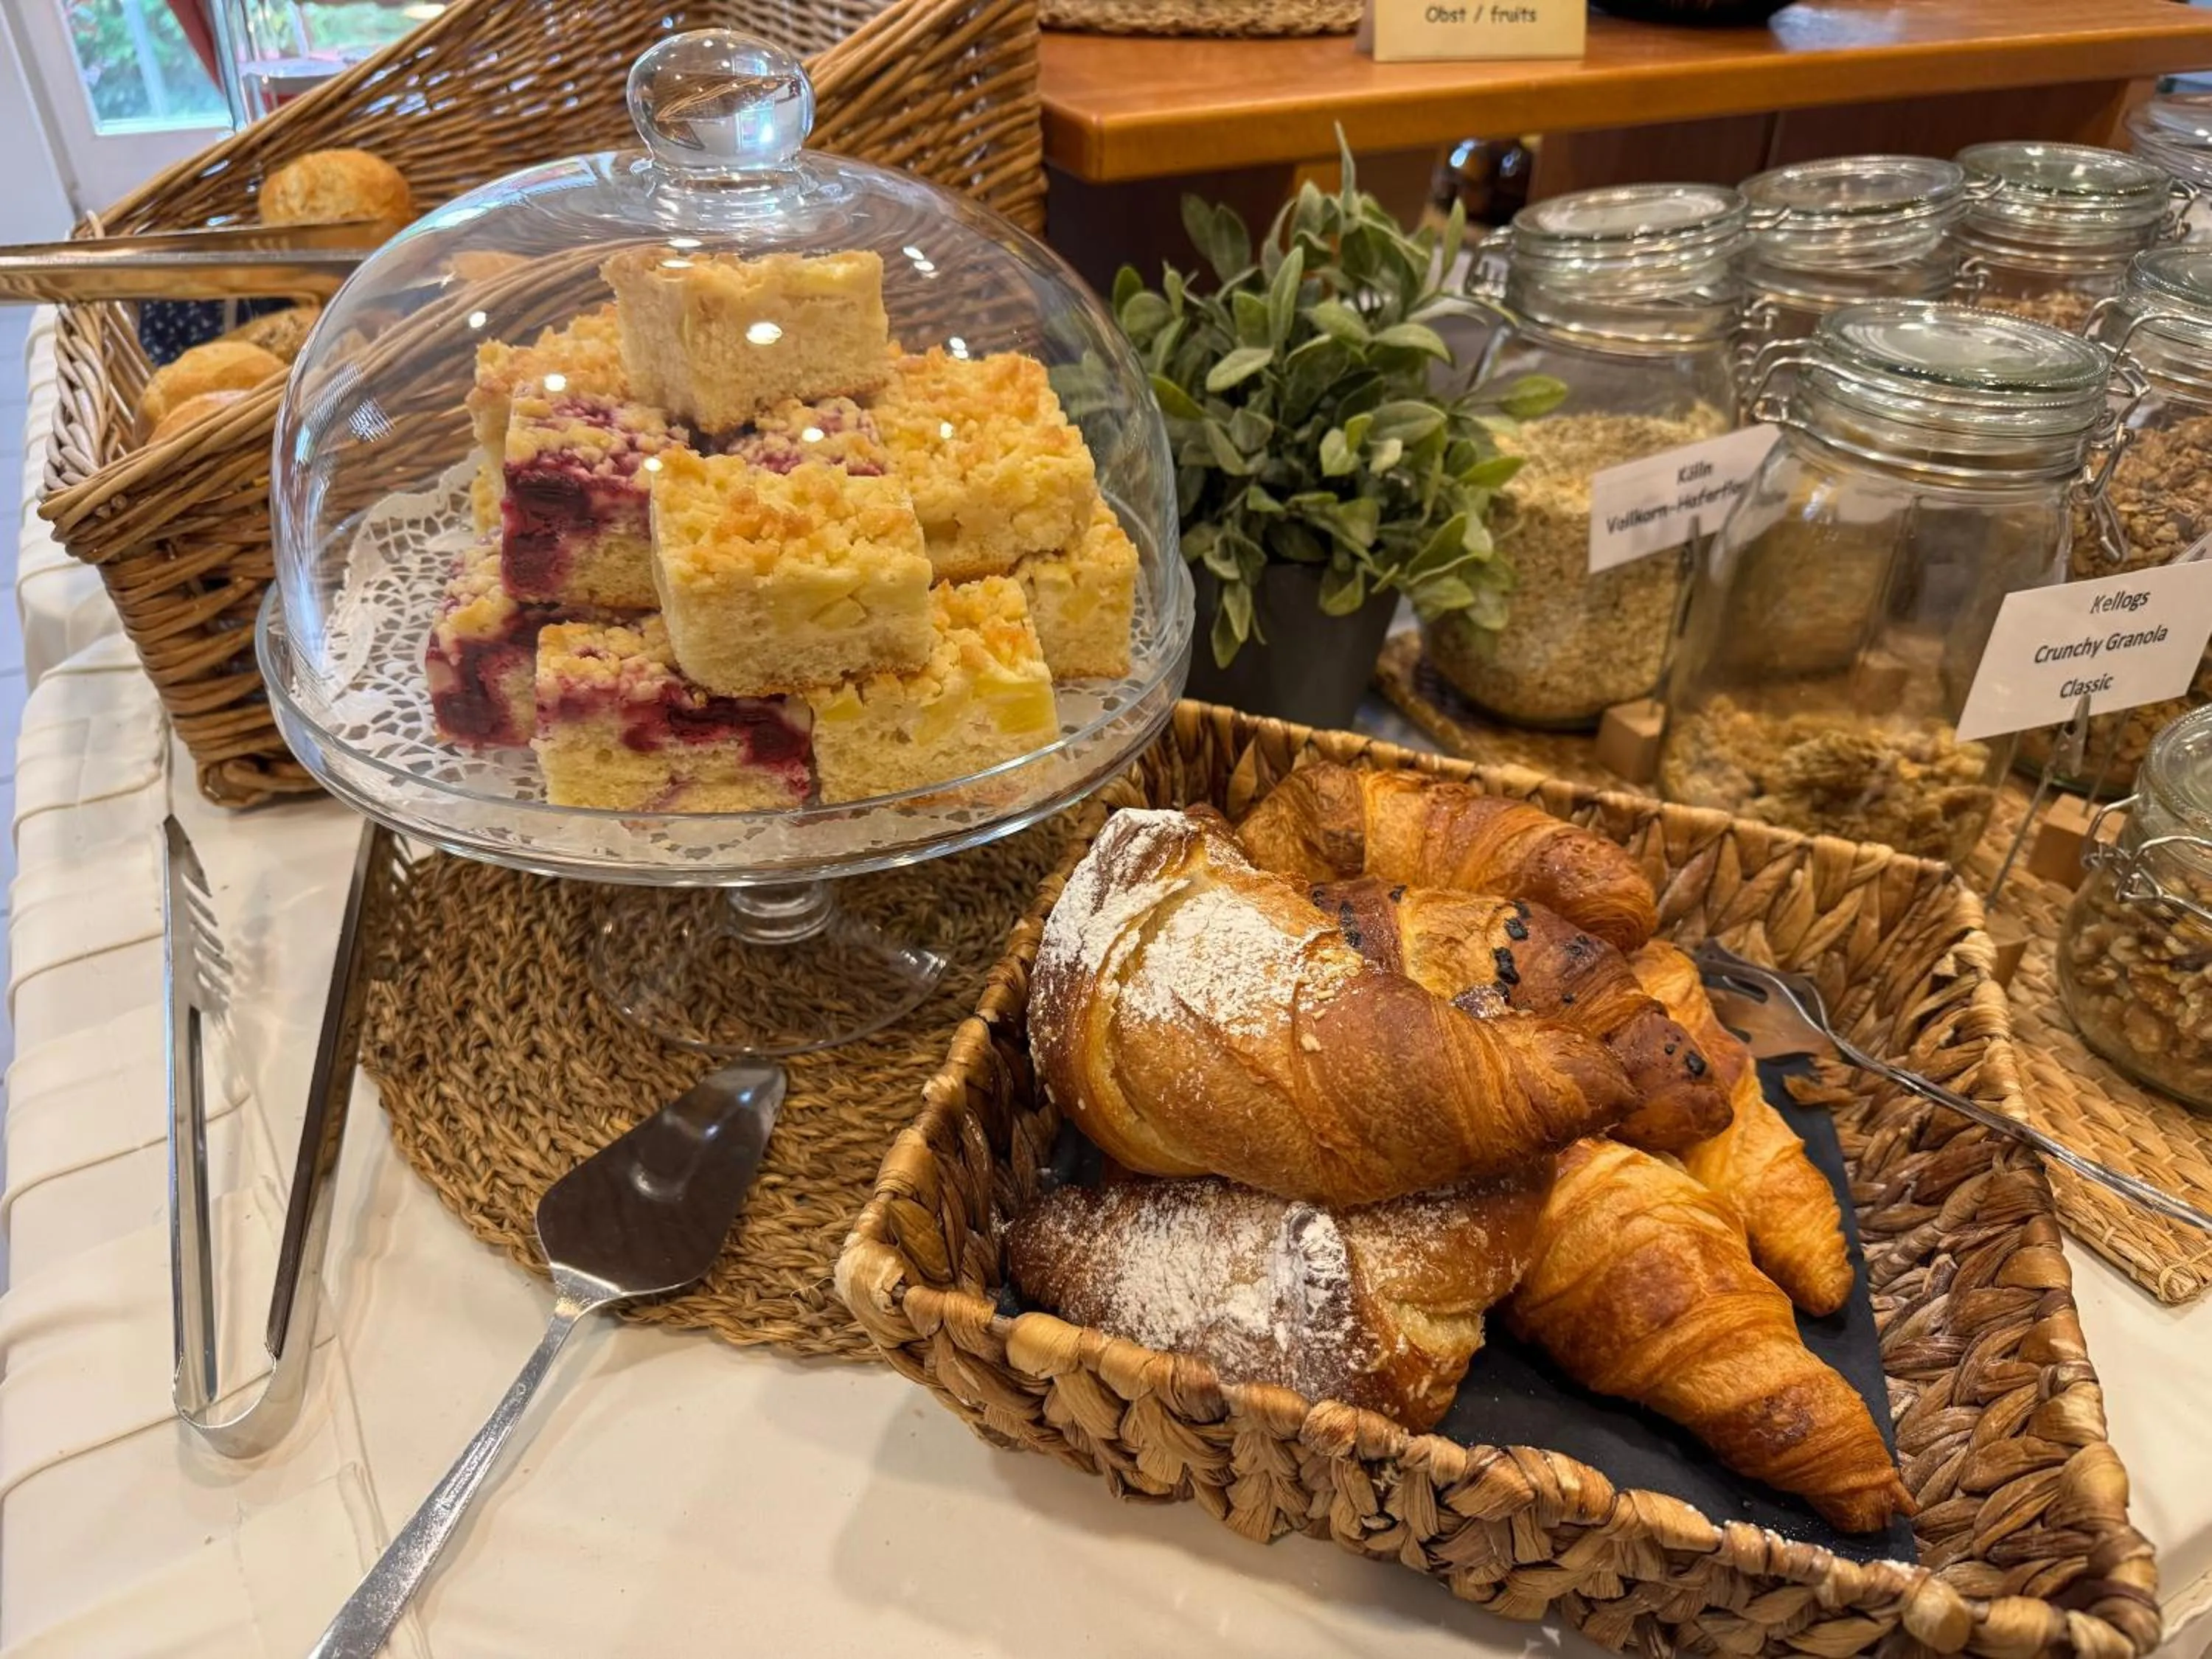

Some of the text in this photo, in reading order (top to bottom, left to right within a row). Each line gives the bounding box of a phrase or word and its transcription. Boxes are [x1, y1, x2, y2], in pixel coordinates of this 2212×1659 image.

[1425, 4, 1537, 24] Obst / fruits
[1606, 479, 1787, 535] Vollkorn-Haferflo
[2090, 591, 2151, 614] Kellogs
[2034, 625, 2168, 664] Crunchy Granola
[2059, 673, 2114, 699] Classic
